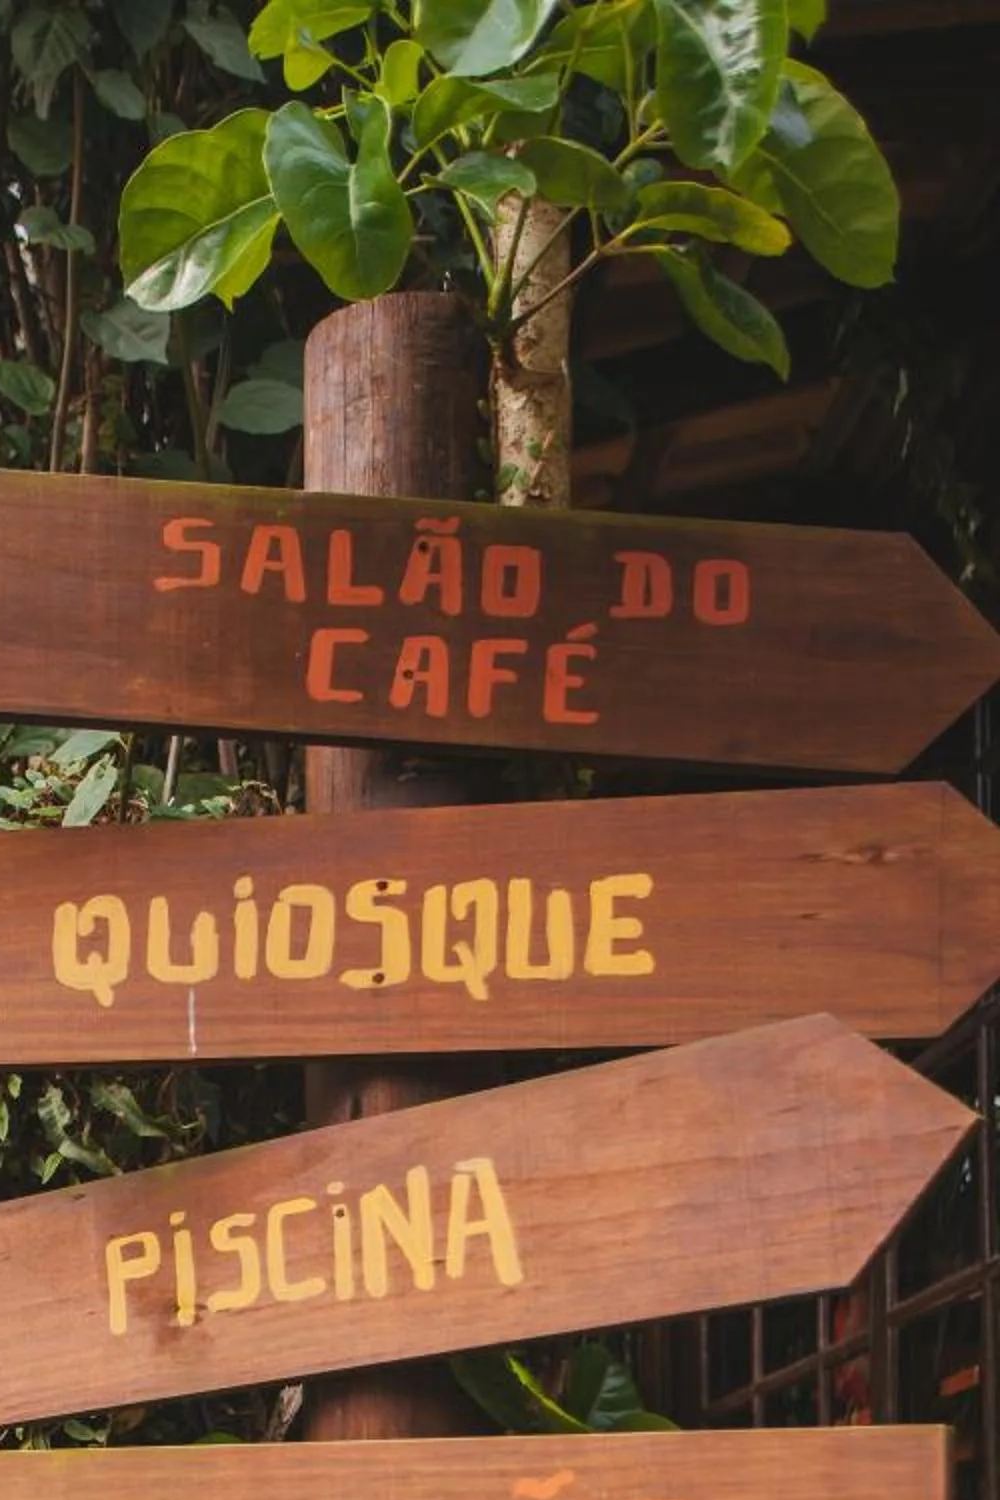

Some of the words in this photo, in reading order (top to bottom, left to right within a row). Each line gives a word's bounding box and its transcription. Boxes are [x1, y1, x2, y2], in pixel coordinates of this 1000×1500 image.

[153, 516, 543, 619] SALÃO
[609, 551, 750, 627] DO
[305, 623, 600, 726] CAFÉ
